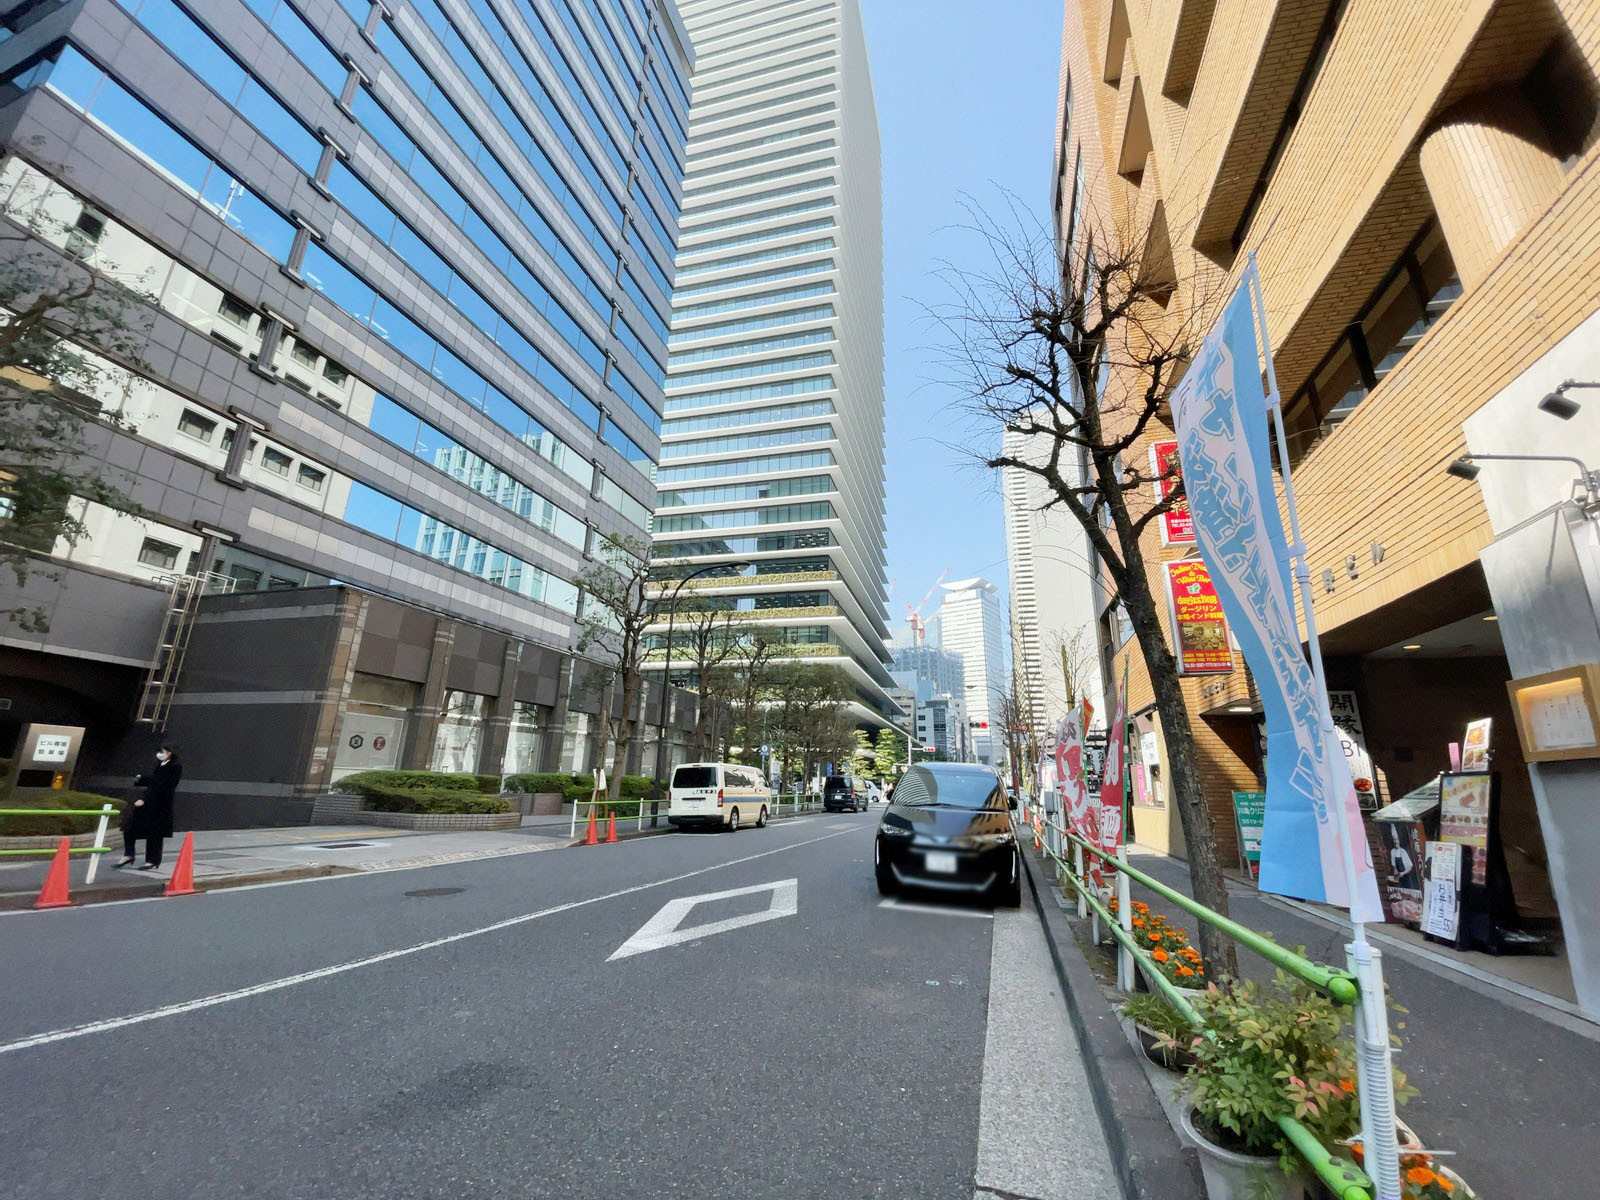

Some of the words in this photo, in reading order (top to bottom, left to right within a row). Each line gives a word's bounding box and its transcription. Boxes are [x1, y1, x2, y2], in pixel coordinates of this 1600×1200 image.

[1181, 605, 1217, 613] ダージリン
